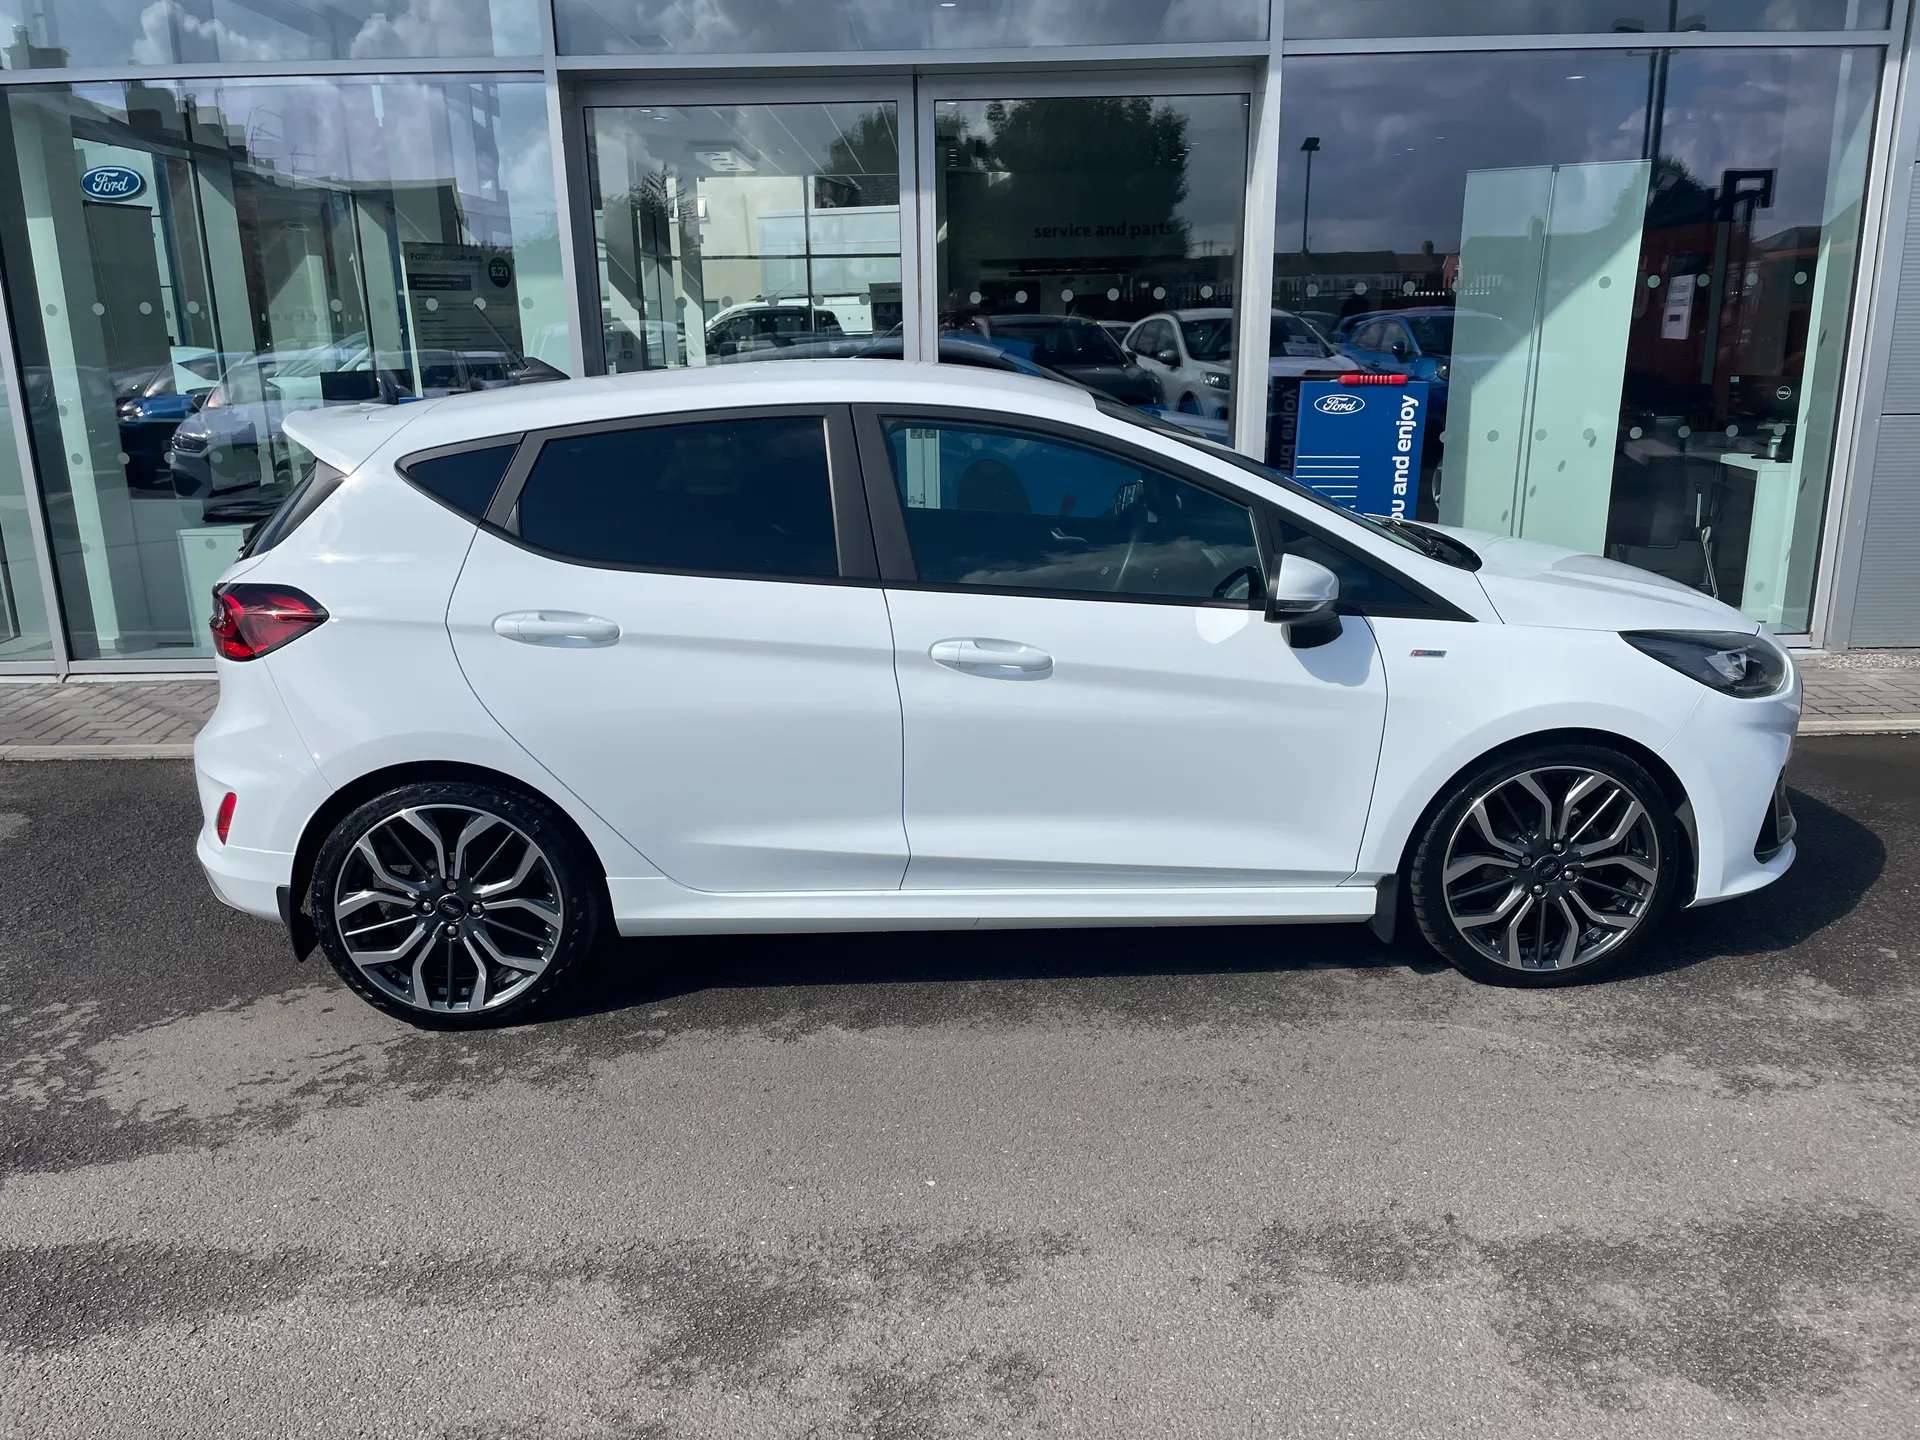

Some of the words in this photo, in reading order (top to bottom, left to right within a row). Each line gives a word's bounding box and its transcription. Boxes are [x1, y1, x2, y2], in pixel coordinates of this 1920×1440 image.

[92, 172, 128, 193] Ford
[1034, 222, 1092, 239] service
[1095, 220, 1127, 237] and
[1130, 222, 1174, 239] parts
[1322, 396, 1356, 412] Ford
[1395, 394, 1419, 452] enjoy
[1391, 455, 1410, 496] and
[1390, 499, 1406, 522] ou
